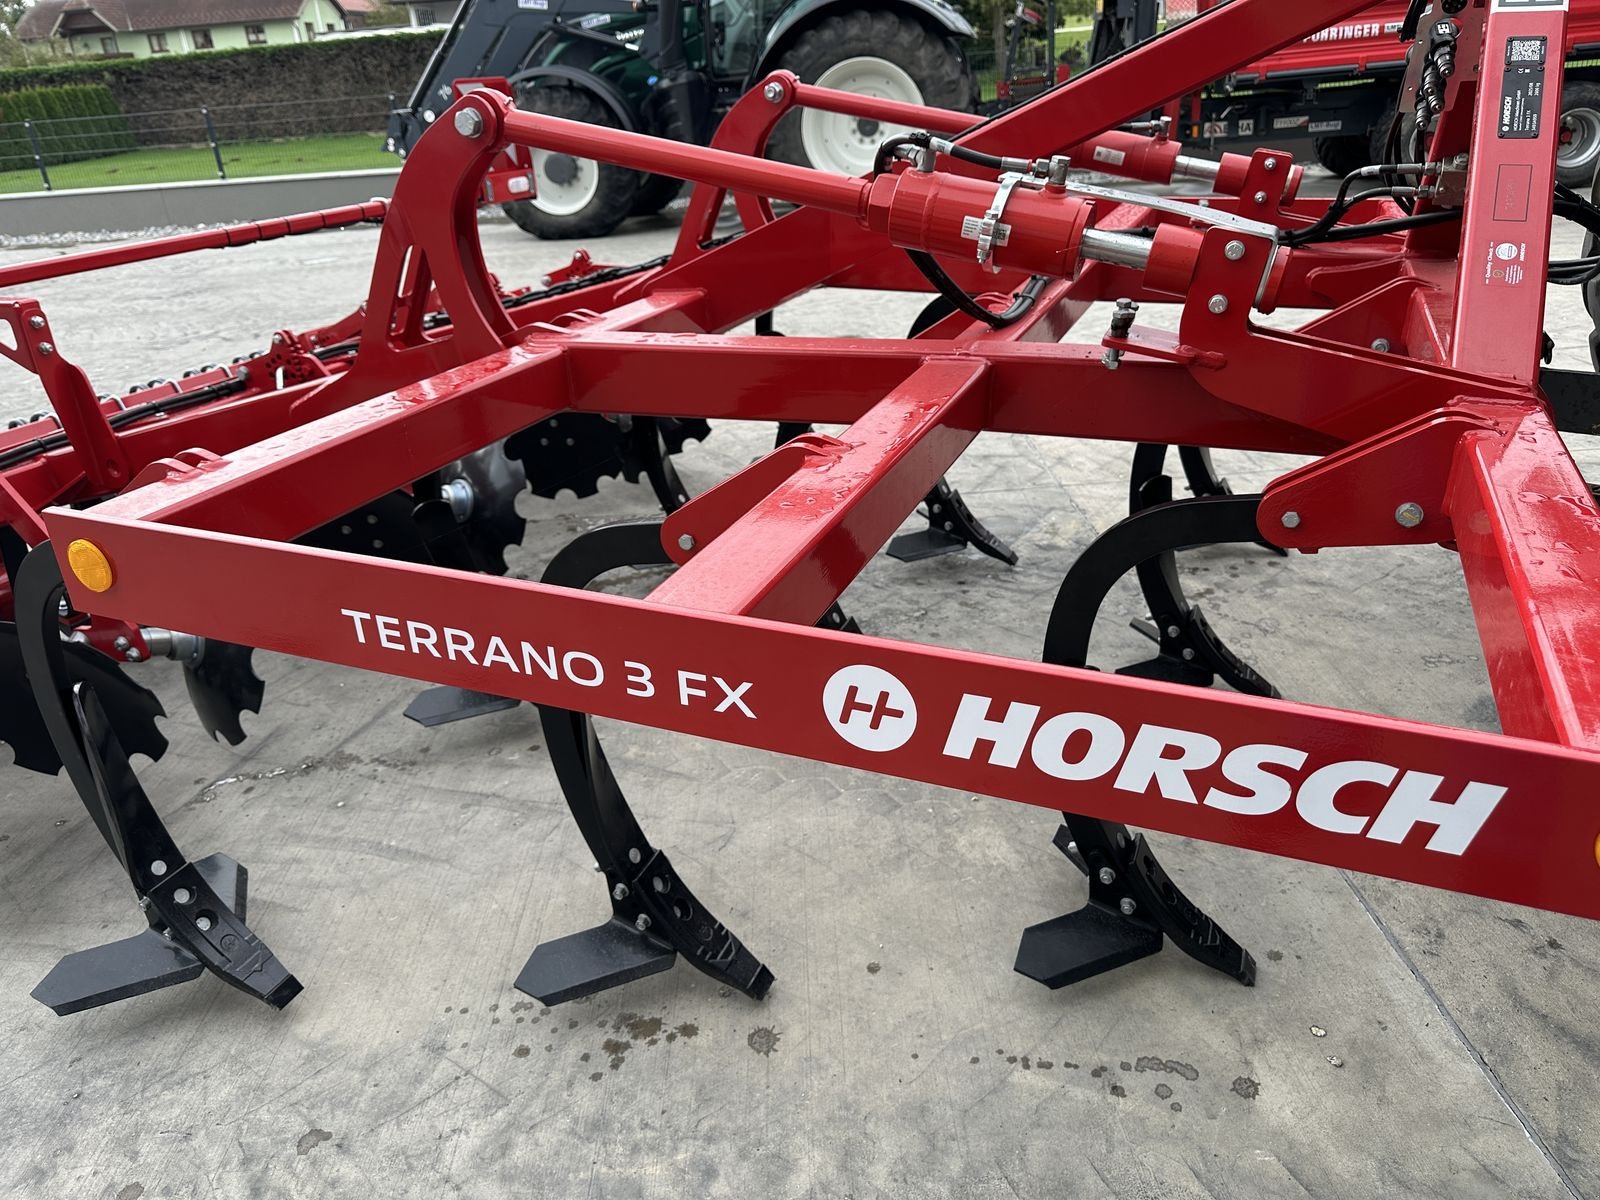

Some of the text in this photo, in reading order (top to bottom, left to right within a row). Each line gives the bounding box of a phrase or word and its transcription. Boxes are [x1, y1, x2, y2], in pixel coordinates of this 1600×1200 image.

[1503, 96, 1512, 125] HORSCH
[341, 608, 757, 719] TERRANO 3 FX
[943, 693, 1508, 856] HORSCH
